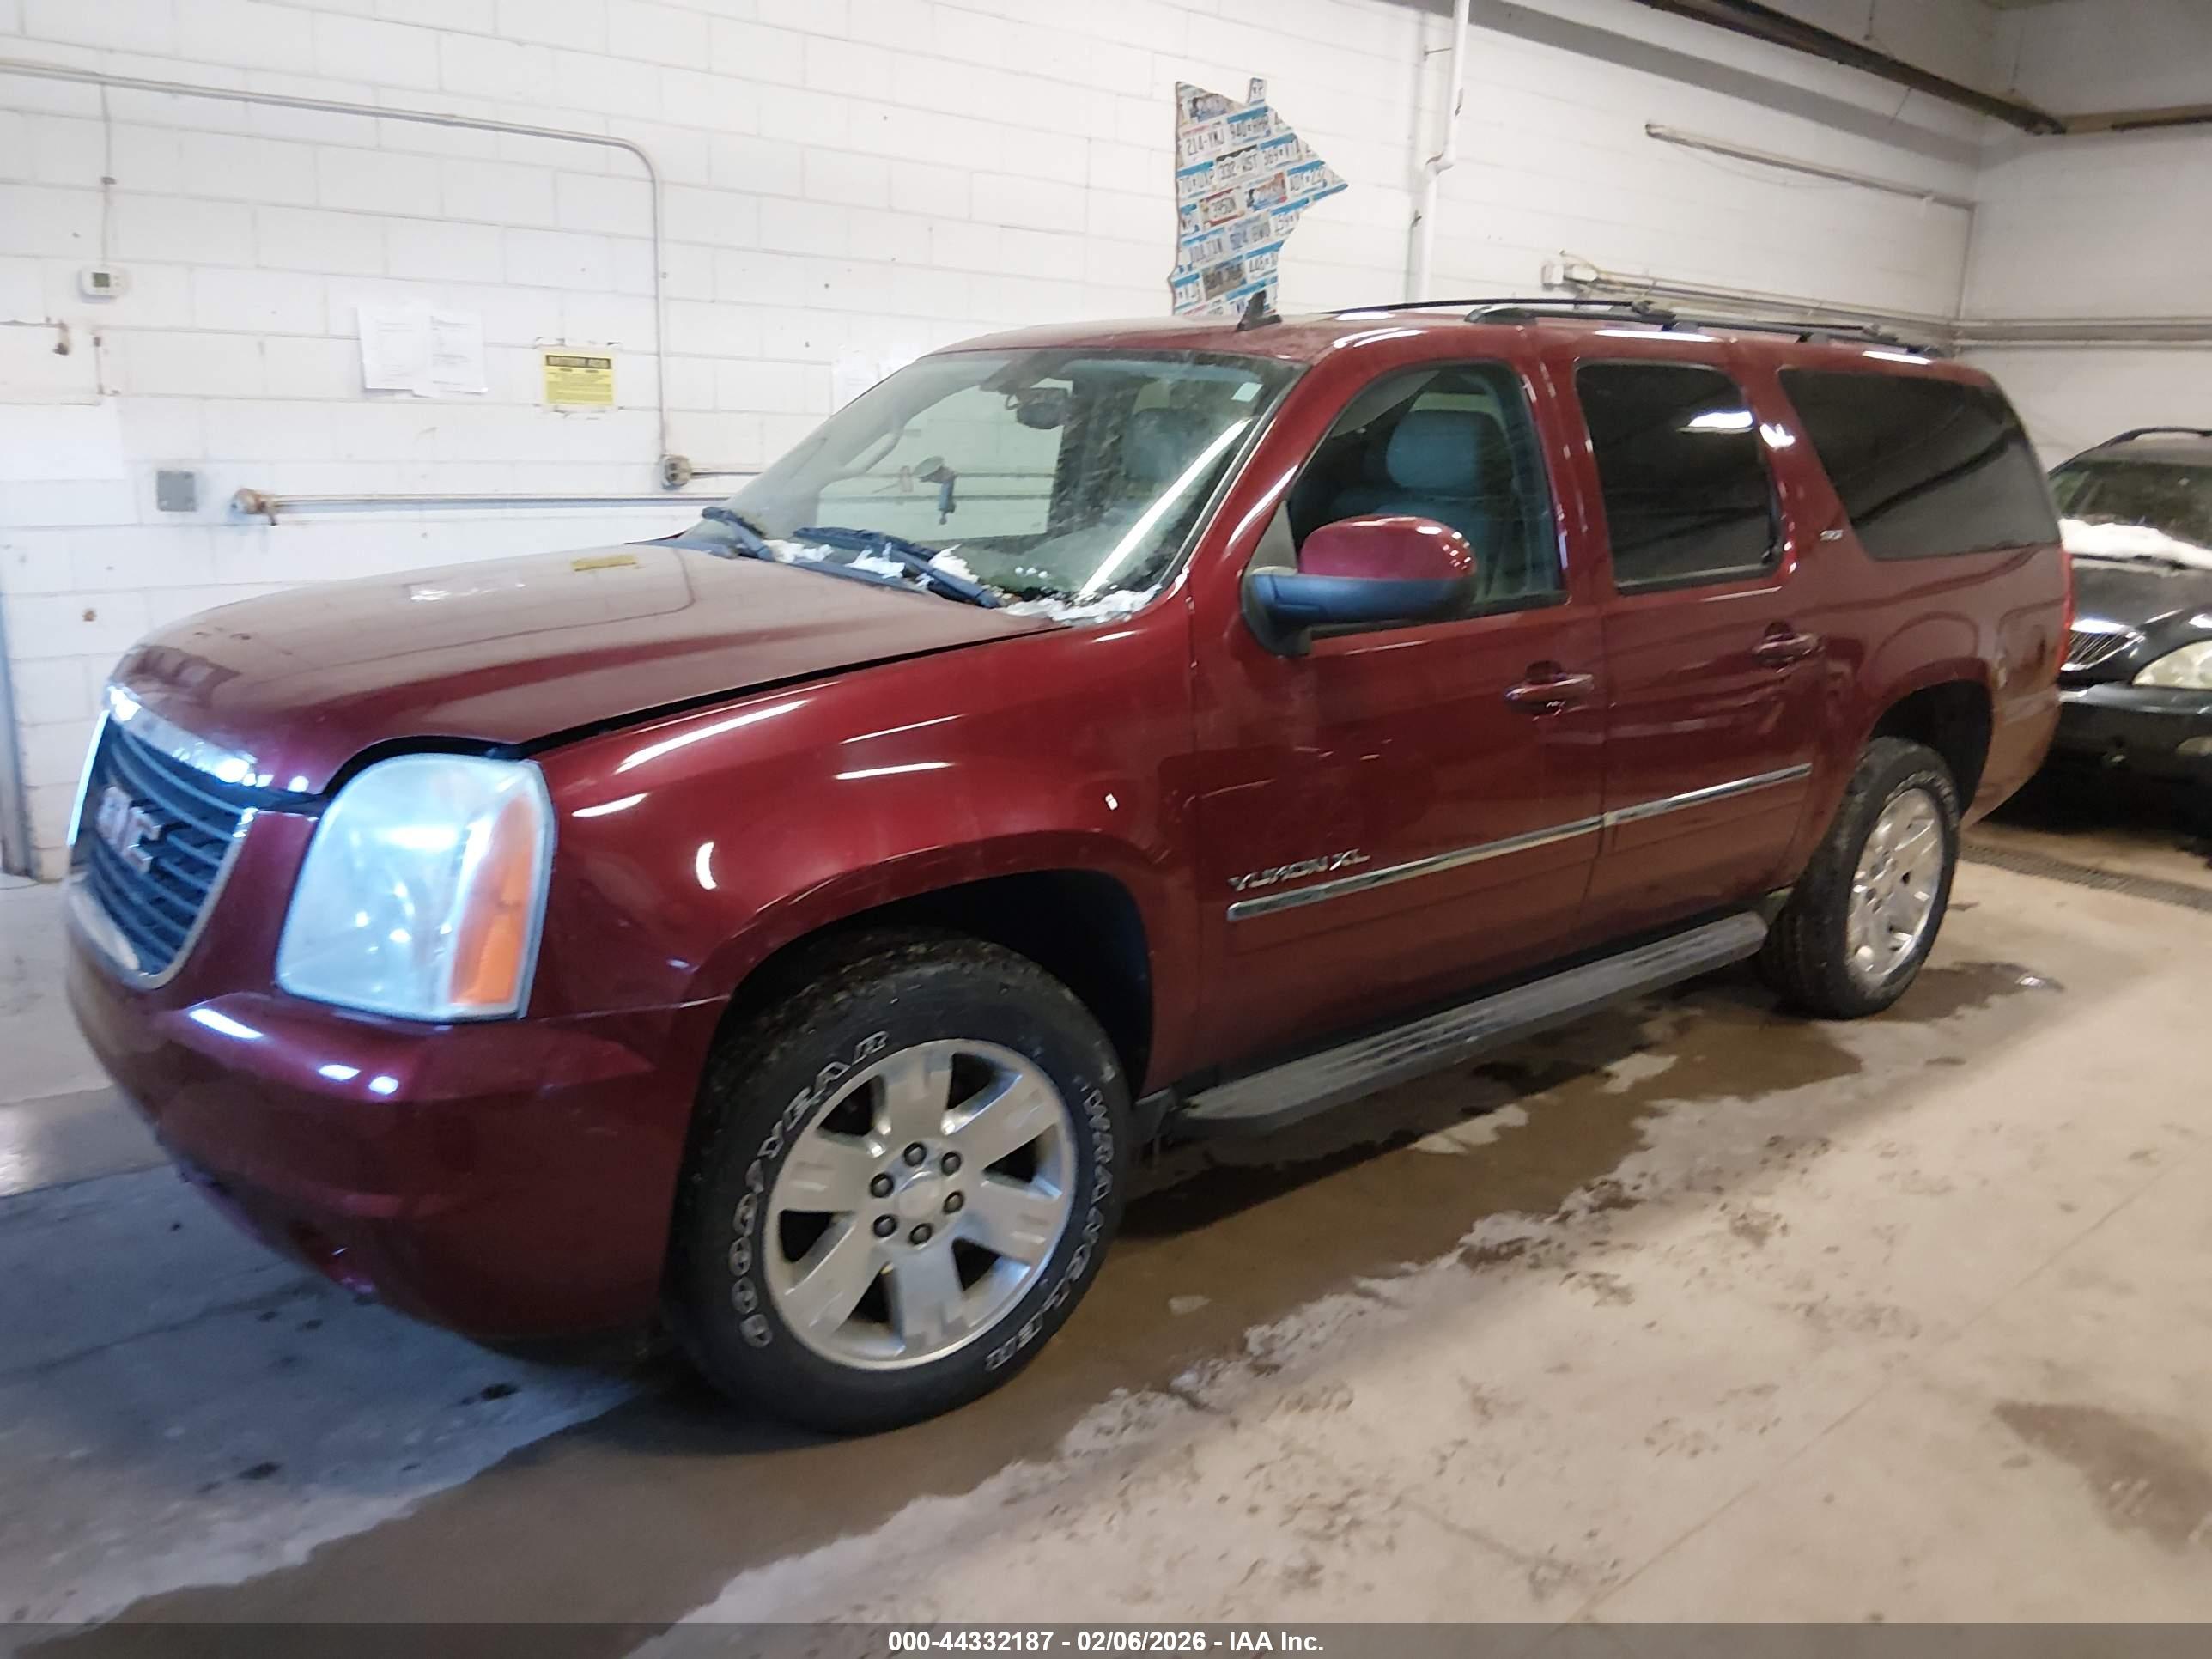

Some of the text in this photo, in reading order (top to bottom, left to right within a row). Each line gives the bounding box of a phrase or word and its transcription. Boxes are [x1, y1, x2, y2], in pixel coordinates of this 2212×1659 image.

[1227, 848, 1371, 892] YUKON XL
[728, 1030, 890, 1348] GOODYEAR
[985, 1088, 1115, 1372] WRANGLER
